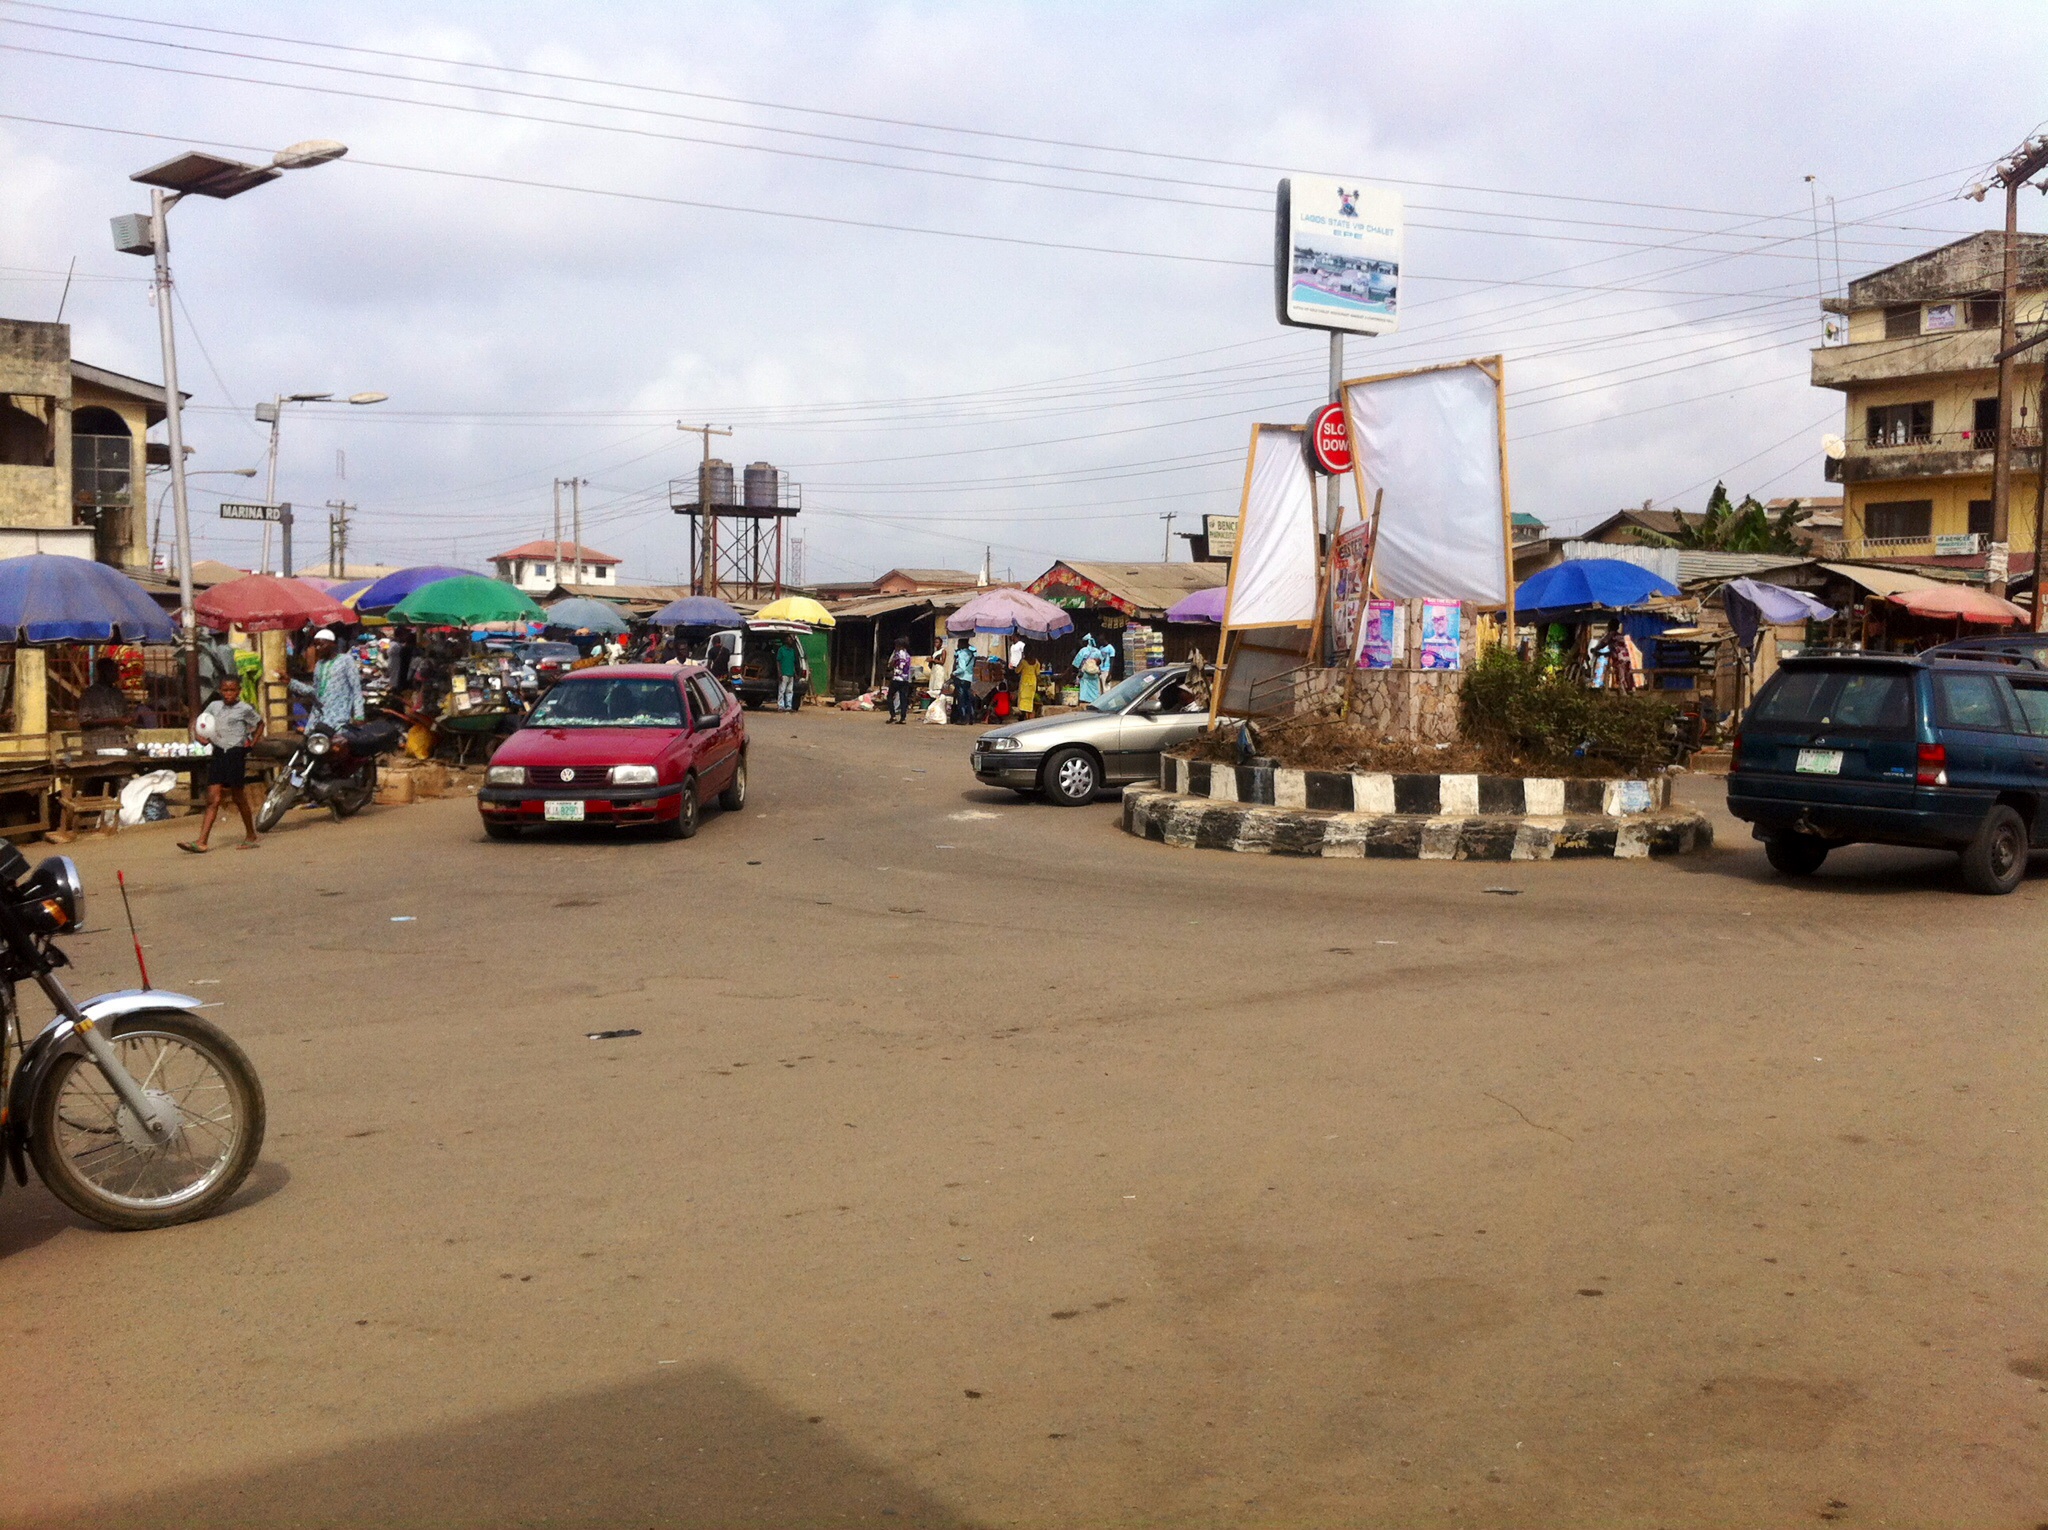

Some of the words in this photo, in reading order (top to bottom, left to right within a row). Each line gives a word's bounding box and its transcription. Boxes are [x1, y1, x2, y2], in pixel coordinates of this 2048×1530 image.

[1300, 213, 1326, 225] LAGOS
[1328, 217, 1350, 229] STATE
[1366, 224, 1394, 236] CHALET
[1323, 422, 1346, 436] SLO
[1323, 439, 1351, 452] DOW
[222, 505, 264, 519] MARINA
[266, 507, 281, 520] RD
